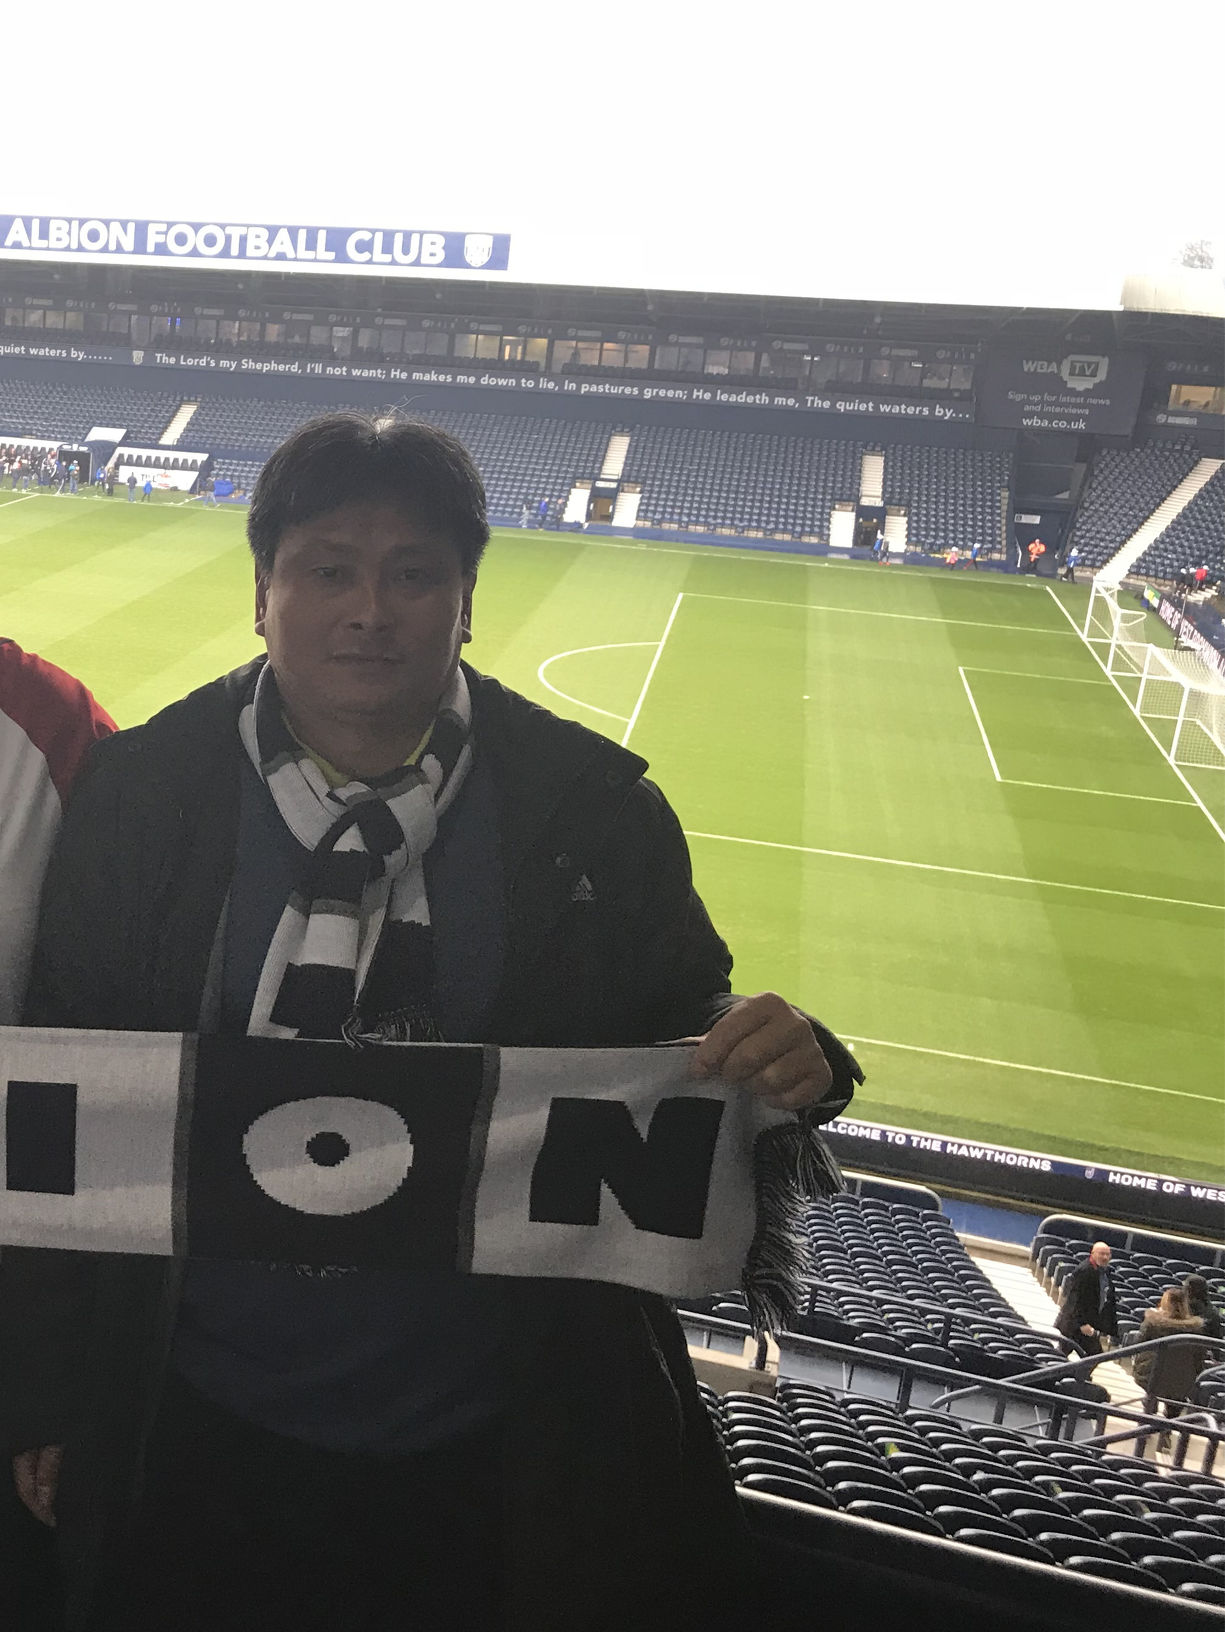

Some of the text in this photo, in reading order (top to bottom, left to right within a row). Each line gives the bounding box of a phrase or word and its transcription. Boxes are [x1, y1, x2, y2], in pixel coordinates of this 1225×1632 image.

[5, 216, 135, 251] ALBION
[146, 222, 336, 260] FOOTBALL
[346, 230, 446, 265] CLUB
[29, 347, 67, 358] waters
[1022, 360, 1096, 375] WBA TV
[155, 353, 176, 365] The
[219, 360, 236, 371] my
[241, 359, 301, 375] Shepherd,
[326, 365, 347, 376] not
[352, 368, 386, 380] want;
[391, 369, 408, 380] He
[412, 370, 452, 383] makes
[456, 374, 476, 384] me
[480, 374, 516, 387] down
[521, 377, 534, 388] to
[539, 378, 558, 391] lie,
[564, 380, 576, 391] In
[581, 381, 639, 396] pastures
[644, 386, 688, 400] green;
[693, 389, 711, 401] He
[717, 389, 769, 405] leadeth
[775, 395, 799, 408] me,
[806, 396, 830, 408] The
[836, 398, 874, 414] quiet
[880, 402, 929, 416] waters
[1008, 391, 1111, 405] Sign up for latest news
[1024, 404, 1089, 415] and interviews
[1022, 416, 1086, 430] wba.co.uk
[885, 1130, 906, 1145] TO
[911, 1135, 941, 1152] THE
[945, 1142, 1053, 1172] HAWTHORNS
[1107, 1171, 1158, 1191] HOME
[1162, 1180, 1185, 1197] OF
